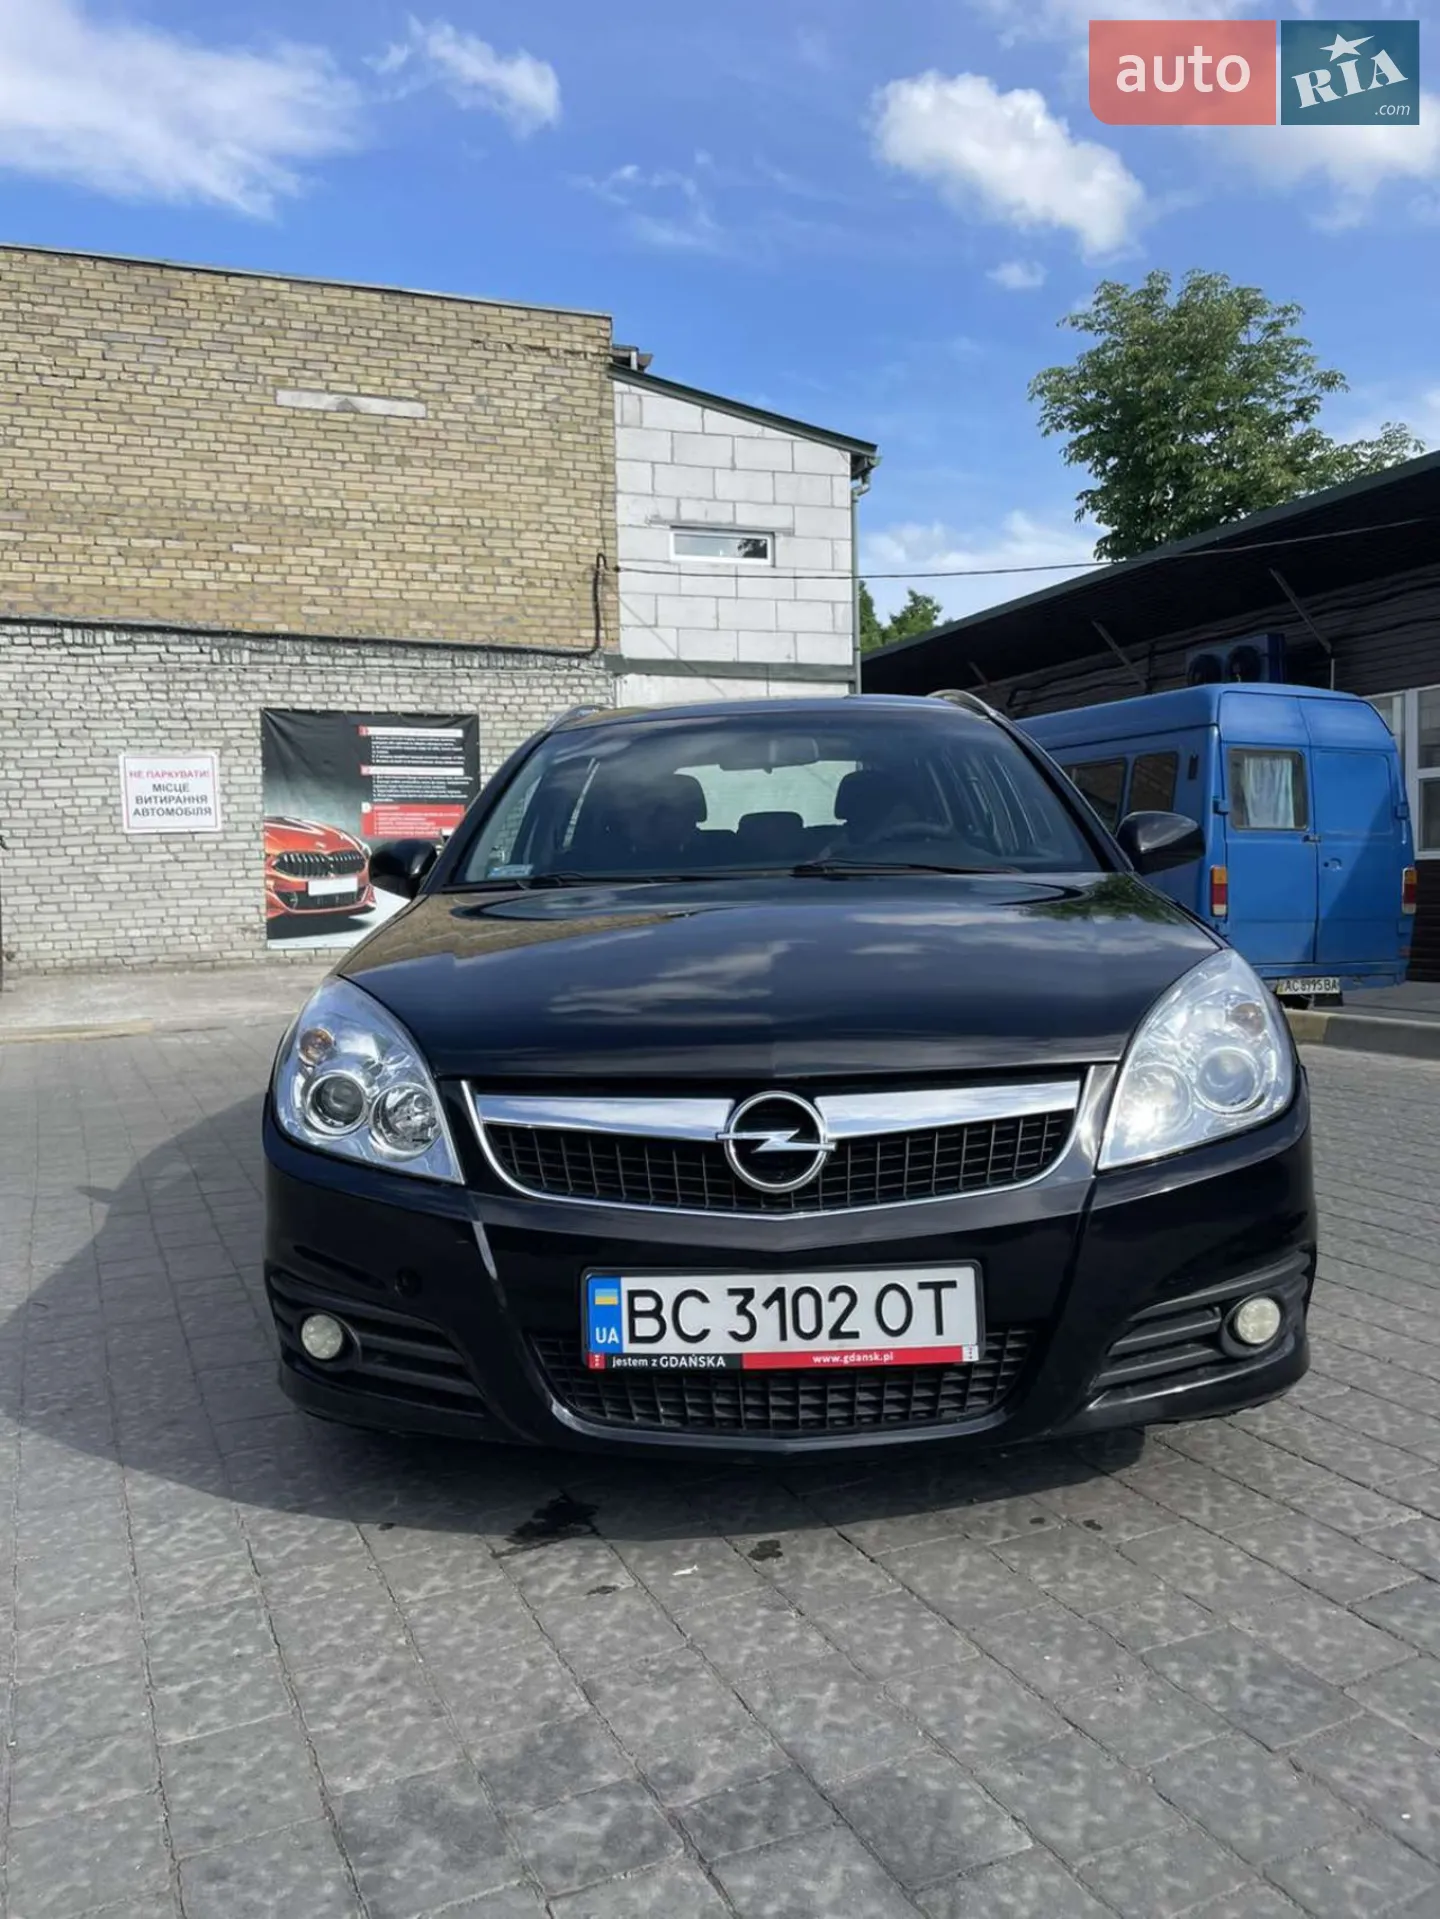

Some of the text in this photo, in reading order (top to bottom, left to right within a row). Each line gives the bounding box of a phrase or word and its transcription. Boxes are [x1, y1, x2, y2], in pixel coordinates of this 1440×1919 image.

[129, 770, 145, 778] НЕ
[152, 783, 190, 793] МІСЦЕ
[135, 794, 209, 805] ВИТИРАННЯ
[132, 806, 213, 817] АВТОМОБІЛЯ
[626, 1280, 958, 1344] BC 3102 OT
[595, 1327, 620, 1344] UA
[612, 1351, 894, 1368] jestem z GDAŃSKA www.gdansk.pl
